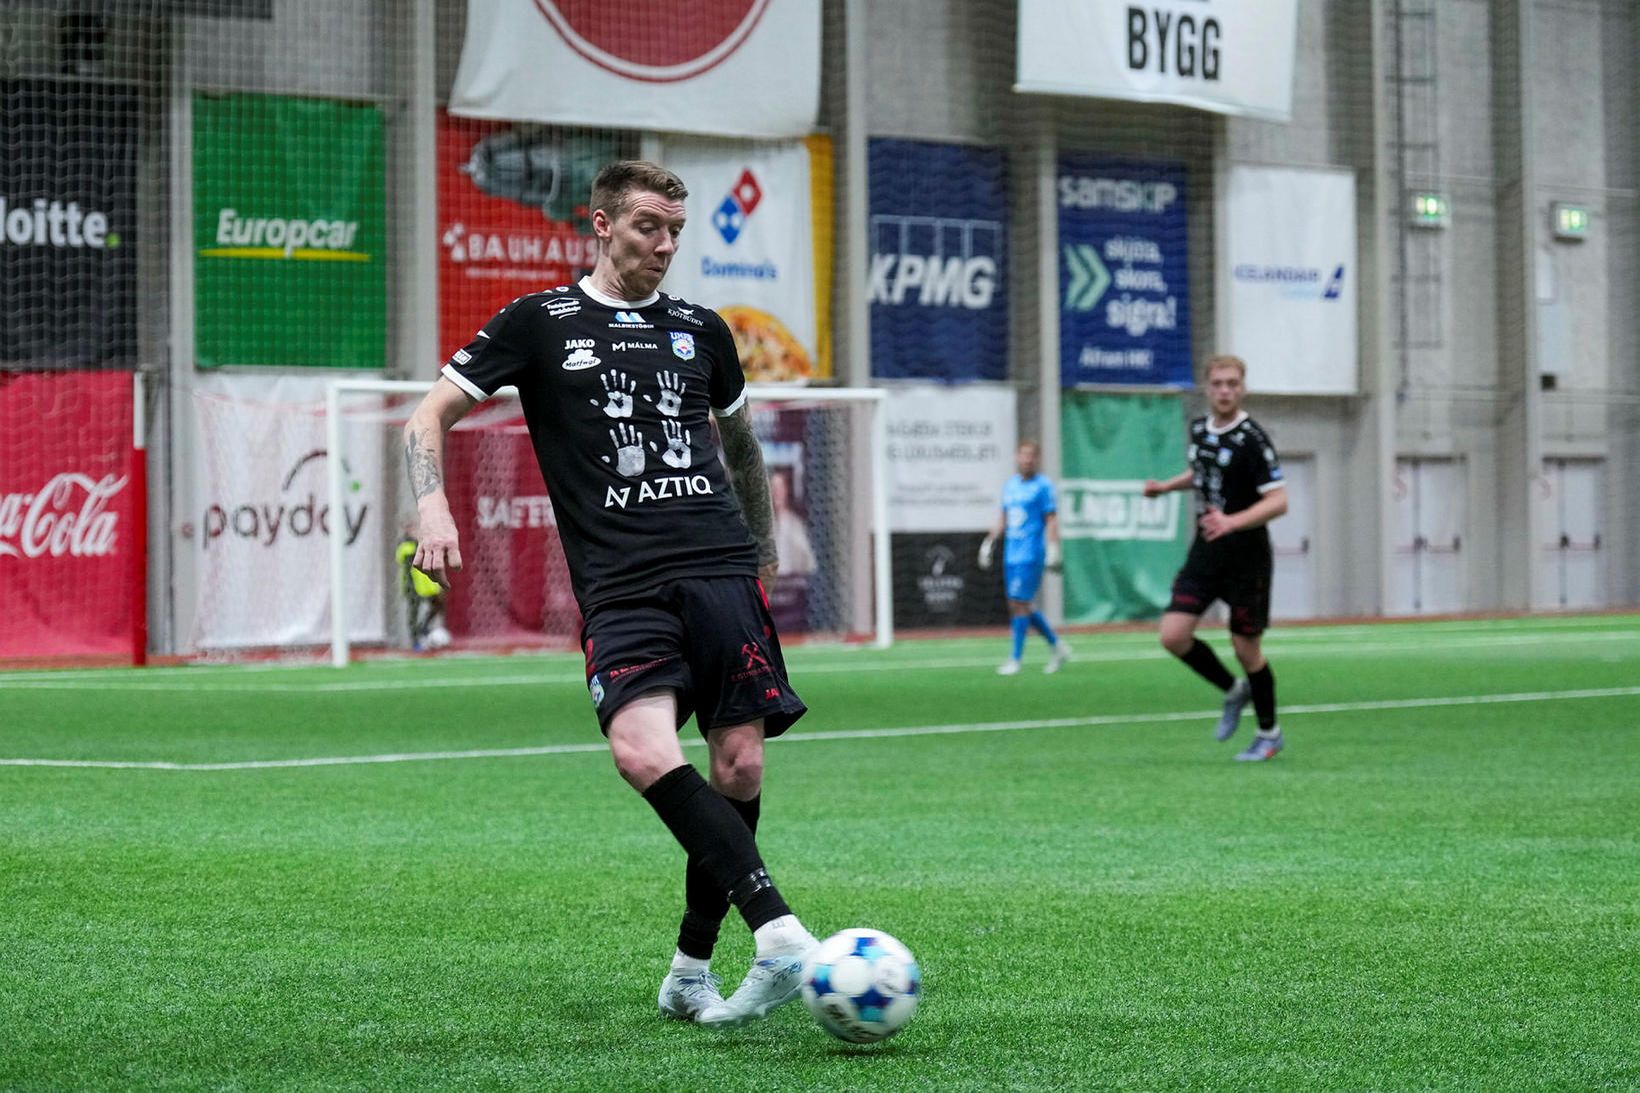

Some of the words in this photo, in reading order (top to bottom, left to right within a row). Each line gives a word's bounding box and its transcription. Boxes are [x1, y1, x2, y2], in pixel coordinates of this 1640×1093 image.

[1127, 7, 1220, 80] BYGG
[216, 208, 357, 259] Europcar
[868, 253, 997, 309] KPMG
[564, 339, 596, 350] JAKO
[627, 342, 658, 350] MÁLMA
[637, 475, 713, 503] AZTIQ
